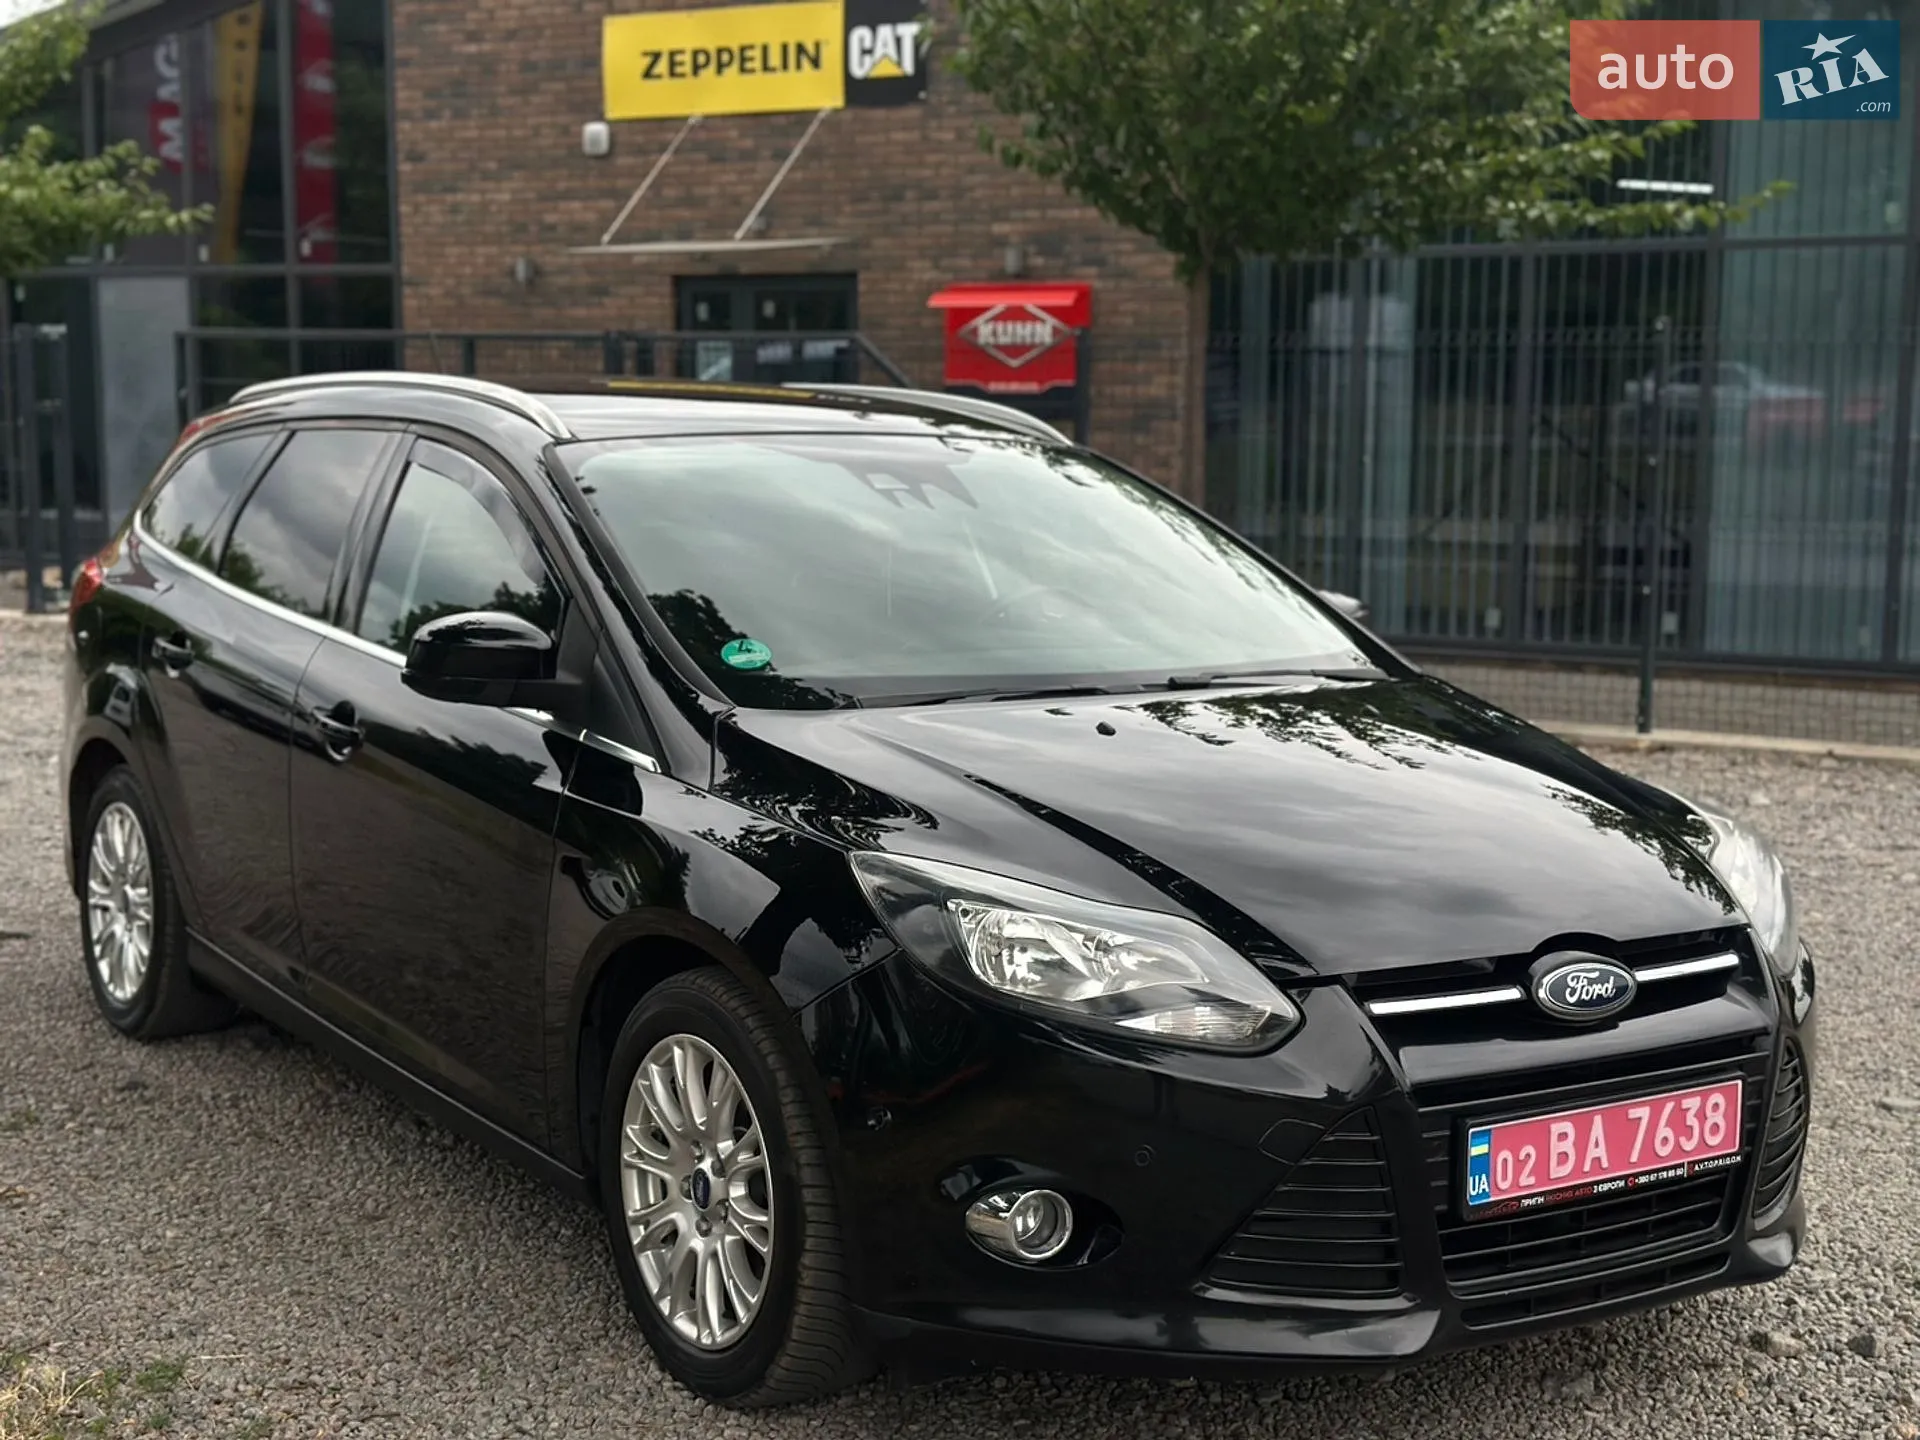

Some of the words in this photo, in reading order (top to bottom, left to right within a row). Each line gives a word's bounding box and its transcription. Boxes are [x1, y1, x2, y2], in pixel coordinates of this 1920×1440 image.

[641, 41, 822, 80] ZEPPELIN
[849, 22, 922, 79] CAT
[976, 321, 1054, 345] KUHN
[1565, 971, 1616, 1003] Ford
[1496, 1145, 1536, 1190] 02
[1549, 1115, 1609, 1180] BA
[1627, 1092, 1727, 1164] 7638
[1469, 1174, 1489, 1196] UA
